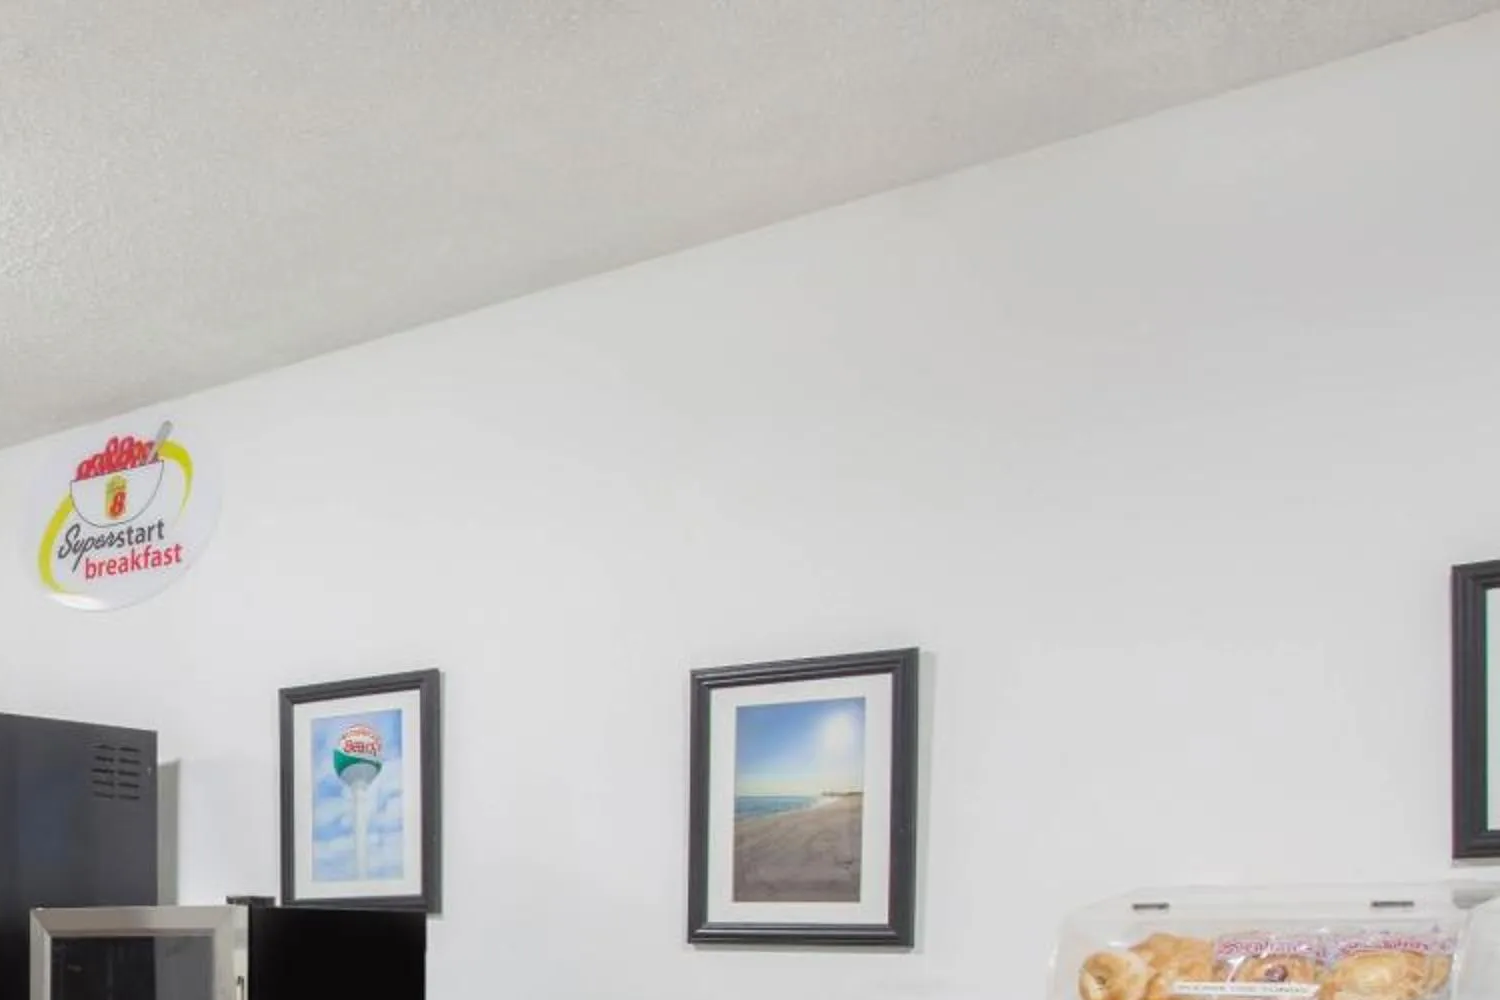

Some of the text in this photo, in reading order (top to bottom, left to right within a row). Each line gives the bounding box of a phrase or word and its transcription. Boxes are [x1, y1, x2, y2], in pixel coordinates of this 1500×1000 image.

[109, 491, 127, 519] 8
[57, 519, 165, 573] Superstart
[85, 543, 182, 580] breakfast
